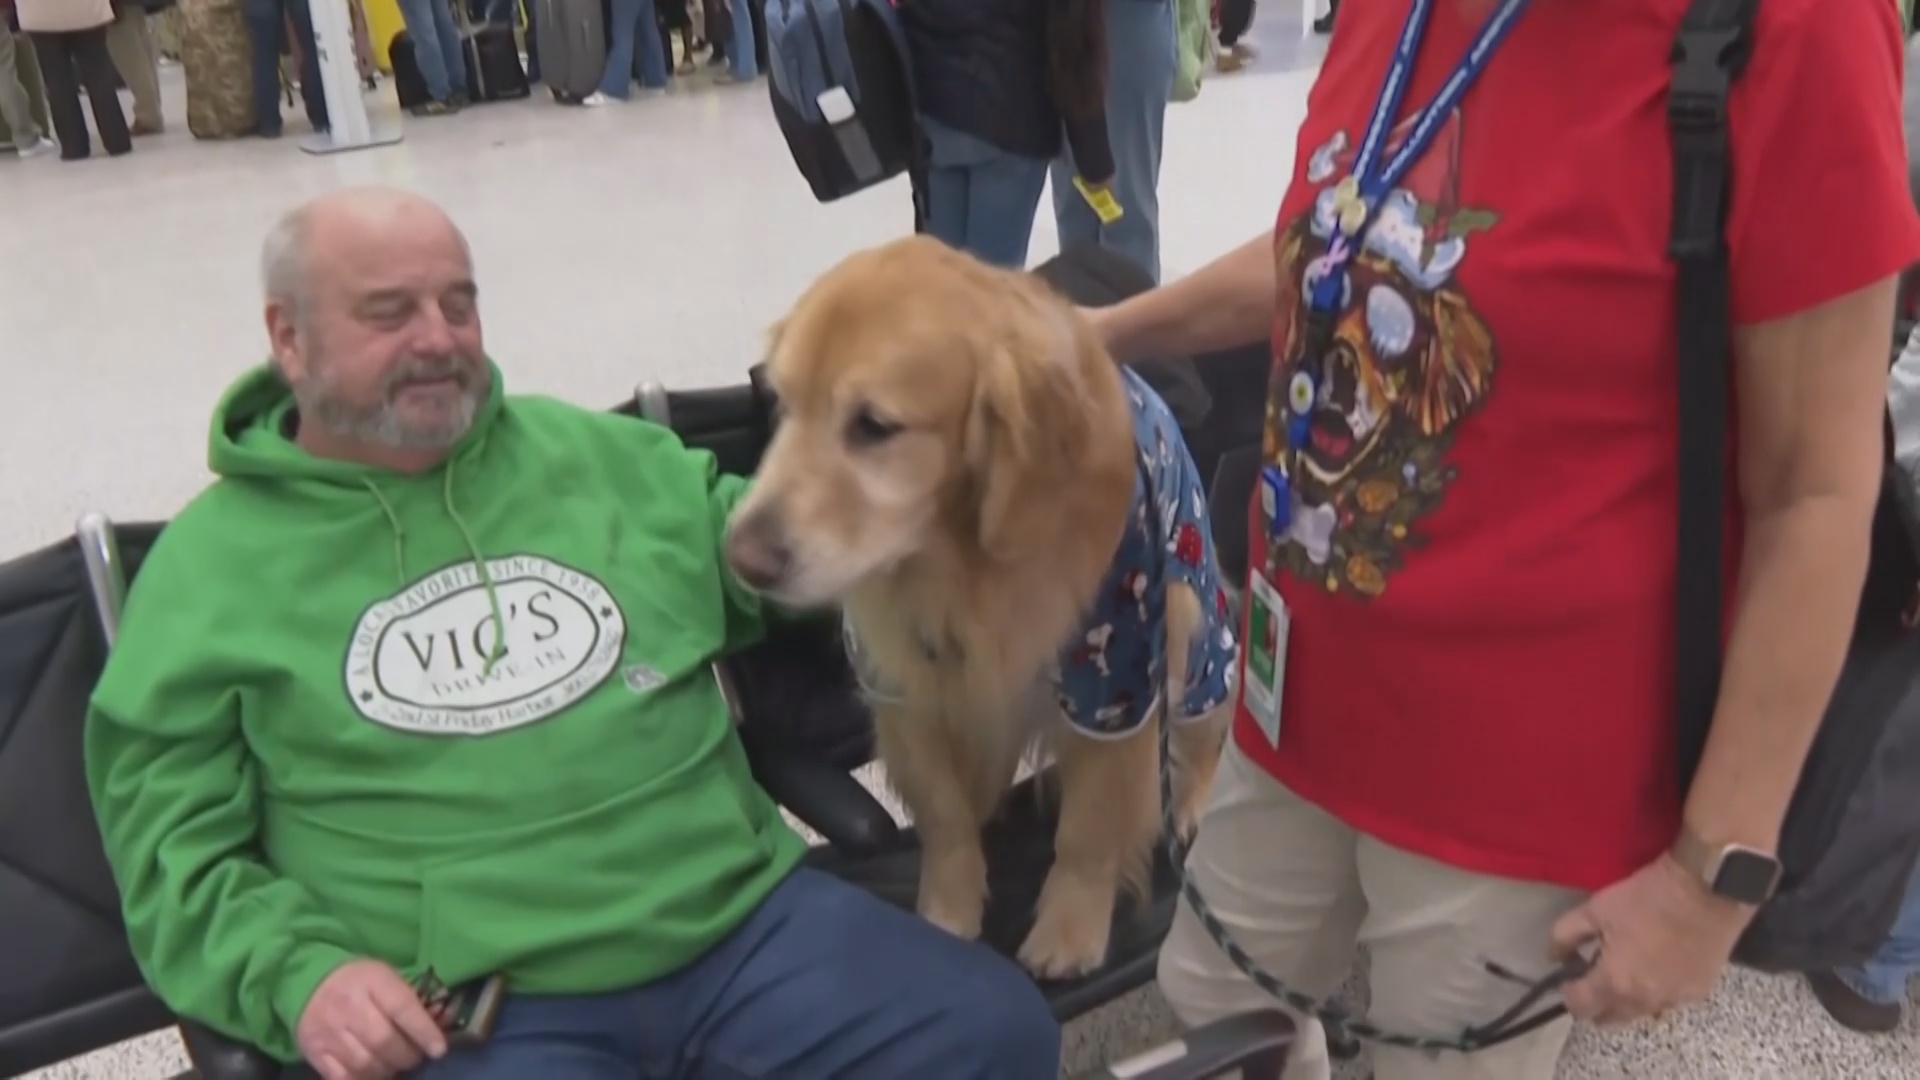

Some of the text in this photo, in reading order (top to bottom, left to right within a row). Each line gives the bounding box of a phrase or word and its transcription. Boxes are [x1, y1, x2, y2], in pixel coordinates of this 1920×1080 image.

[352, 665, 371, 678] A
[392, 564, 480, 616] FAVORIT
[492, 556, 549, 580] SINCE
[557, 566, 600, 601] 1958
[402, 590, 560, 673] VIC'S
[498, 694, 555, 725] Harbor
